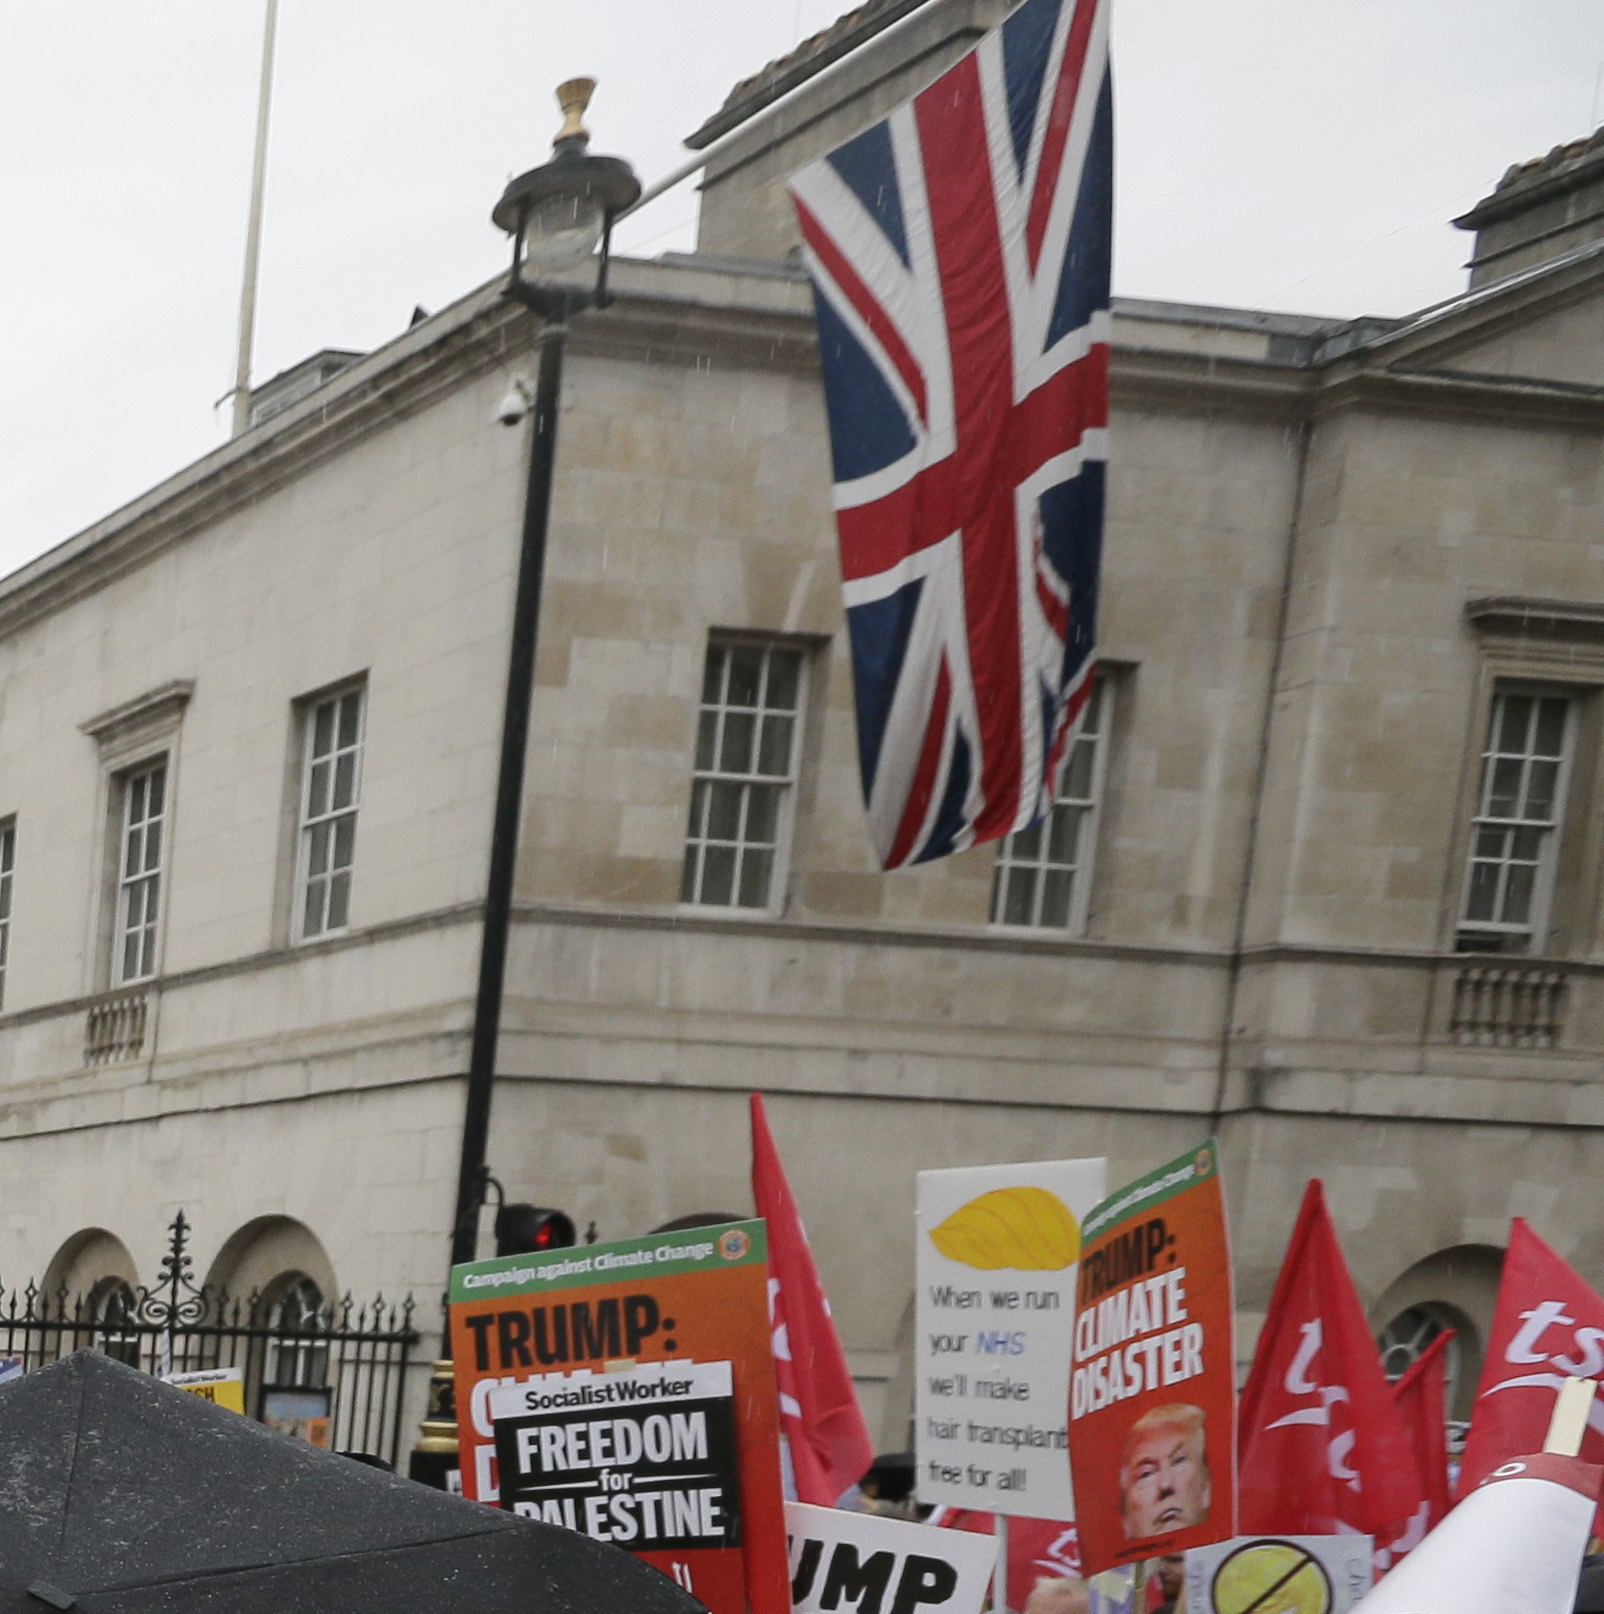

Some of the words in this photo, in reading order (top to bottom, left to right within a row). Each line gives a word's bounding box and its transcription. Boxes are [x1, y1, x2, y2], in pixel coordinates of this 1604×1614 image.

[463, 1263, 536, 1289] Campaign
[537, 1256, 593, 1280] against
[595, 1248, 654, 1270] Climate
[655, 1239, 714, 1263] Change
[1082, 1217, 1177, 1304] TRUMP:
[930, 1286, 982, 1308] When
[989, 1291, 1019, 1309] we
[1024, 1290, 1060, 1309] run
[1076, 1266, 1188, 1363] CLIMATE
[466, 1294, 676, 1373] TRUMP:
[928, 1333, 969, 1357] your
[975, 1331, 1027, 1356] NHS
[928, 1374, 967, 1397] we'll
[974, 1377, 1030, 1401] make
[1072, 1322, 1205, 1421] DISASTER
[525, 1381, 615, 1413] Socialist
[615, 1373, 694, 1405] Worker
[516, 1410, 708, 1474] FREEDOM
[927, 1416, 961, 1440] hair
[597, 1468, 633, 1494] for
[929, 1460, 962, 1484] free
[967, 1463, 991, 1487] for
